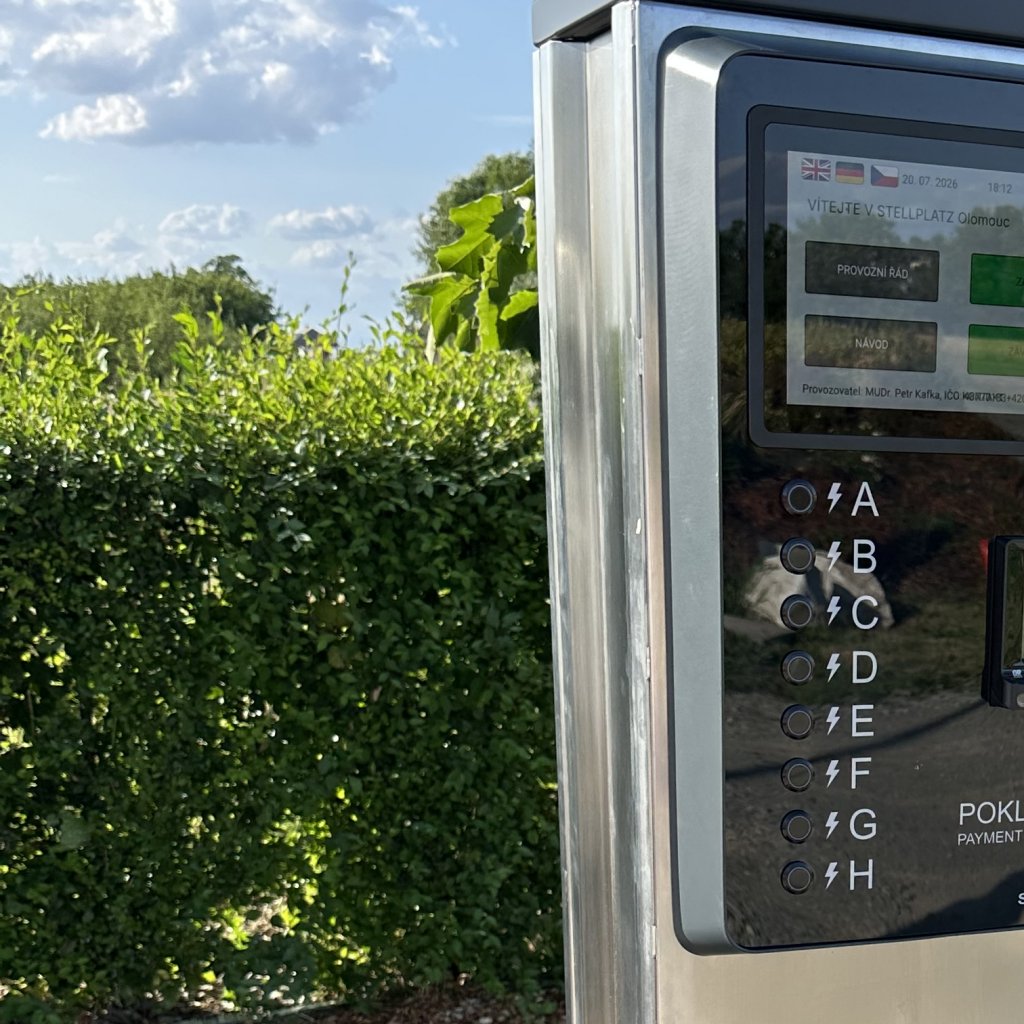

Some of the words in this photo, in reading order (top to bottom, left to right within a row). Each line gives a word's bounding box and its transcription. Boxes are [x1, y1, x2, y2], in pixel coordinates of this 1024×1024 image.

[935, 177, 958, 190] 2026
[807, 197, 861, 216] VÍTEJTE
[865, 204, 874, 217] V
[877, 204, 954, 224] STELLPLATZ
[957, 211, 1011, 228] Olomouc
[837, 264, 887, 278] PROVOZNÍ
[855, 337, 889, 350] NÁVOD
[894, 388, 913, 399] Petr
[851, 481, 880, 517] A
[853, 539, 877, 574] B
[851, 595, 879, 630] C
[852, 650, 878, 684] D
[851, 704, 875, 737] E
[851, 757, 872, 789] F
[850, 808, 877, 840] G
[957, 829, 1024, 846] PAYMENT
[850, 858, 874, 891] H
